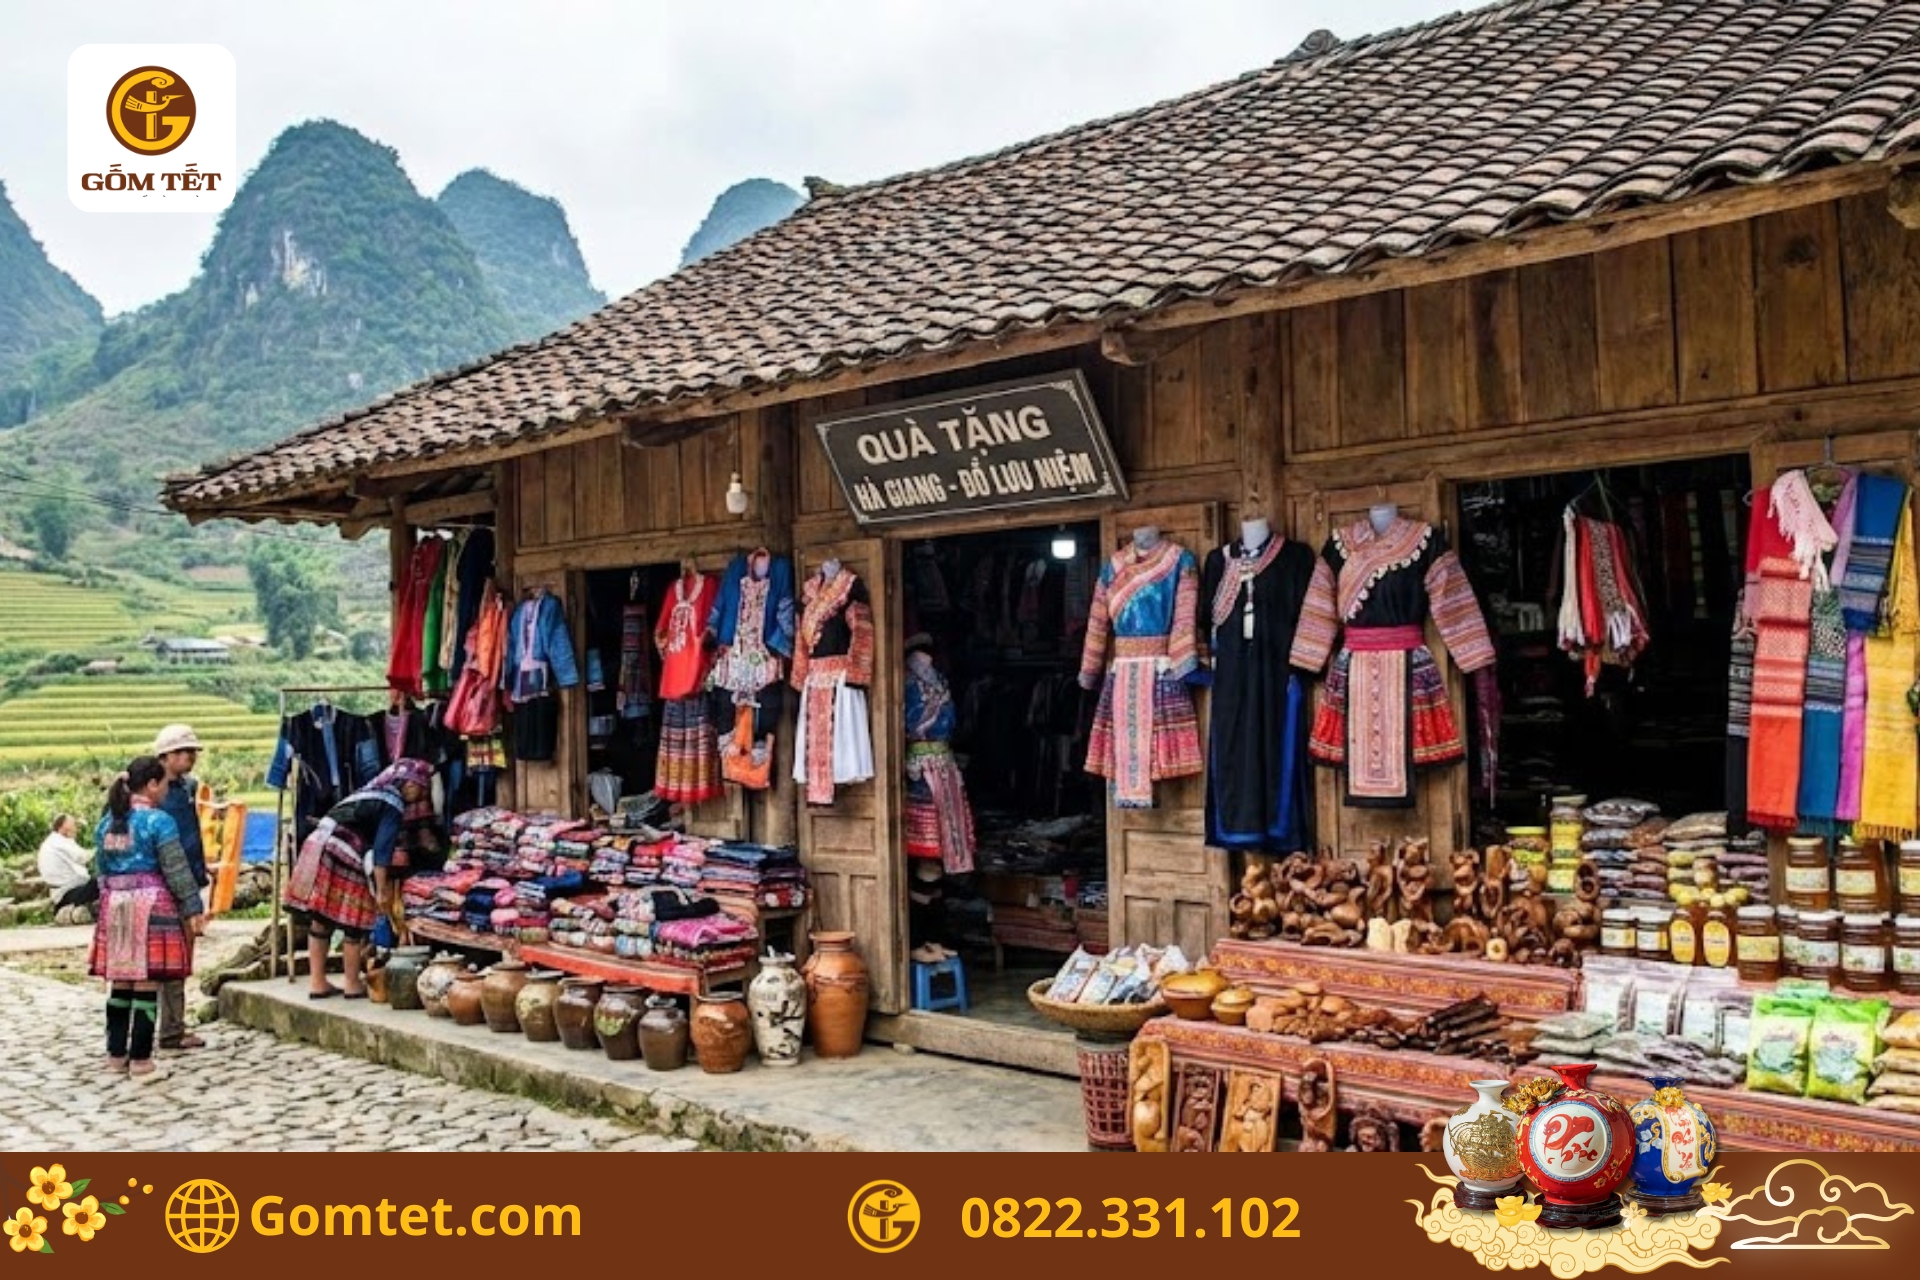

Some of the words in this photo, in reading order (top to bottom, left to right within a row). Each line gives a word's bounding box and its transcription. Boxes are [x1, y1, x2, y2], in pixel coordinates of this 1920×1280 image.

[857, 418, 937, 465] QUÀ
[938, 405, 1051, 456] TẶNG
[884, 473, 947, 508] GIANG
